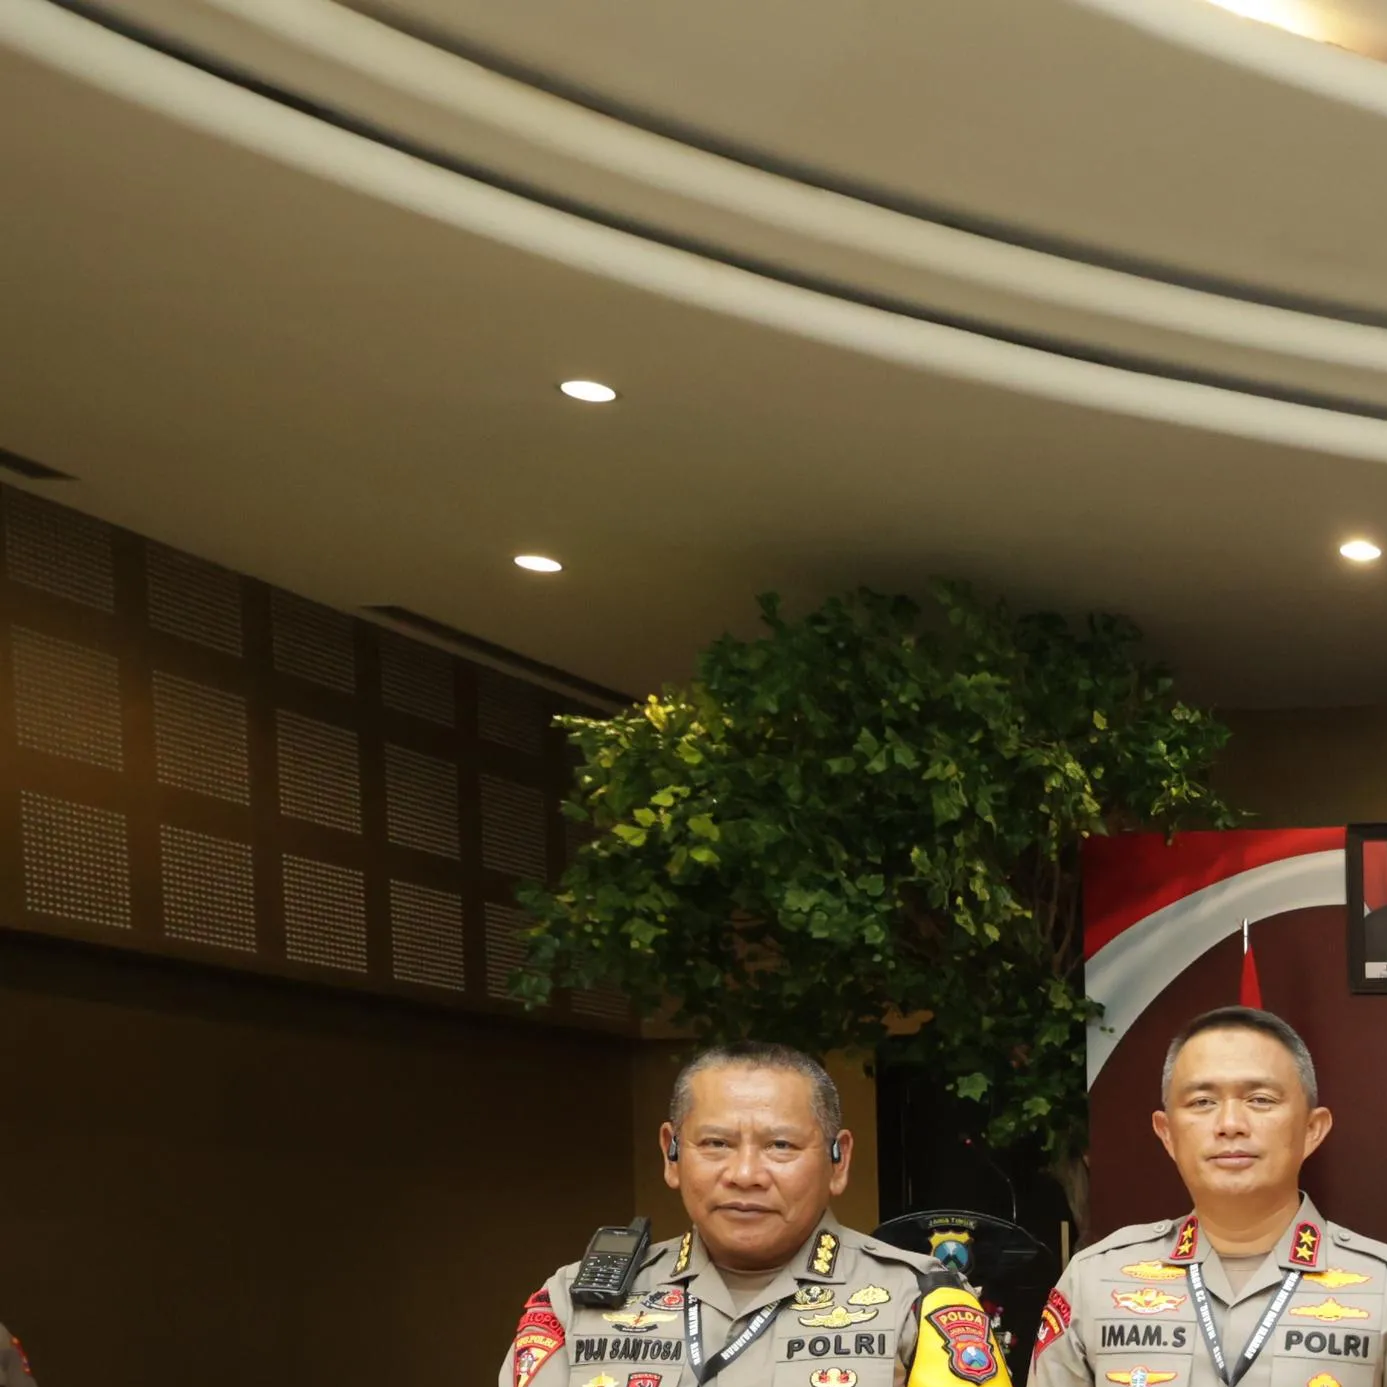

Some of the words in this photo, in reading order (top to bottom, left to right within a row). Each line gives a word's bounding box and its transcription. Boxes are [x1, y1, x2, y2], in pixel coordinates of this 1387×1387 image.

[938, 1311, 984, 1328] POLDA
[786, 1333, 886, 1360] POLRI
[1101, 1324, 1168, 1348] IMAM.
[1172, 1326, 1187, 1348] S
[1284, 1330, 1370, 1359] POLRI
[575, 1338, 606, 1363] PUJI
[609, 1337, 683, 1362] SANTOSA
